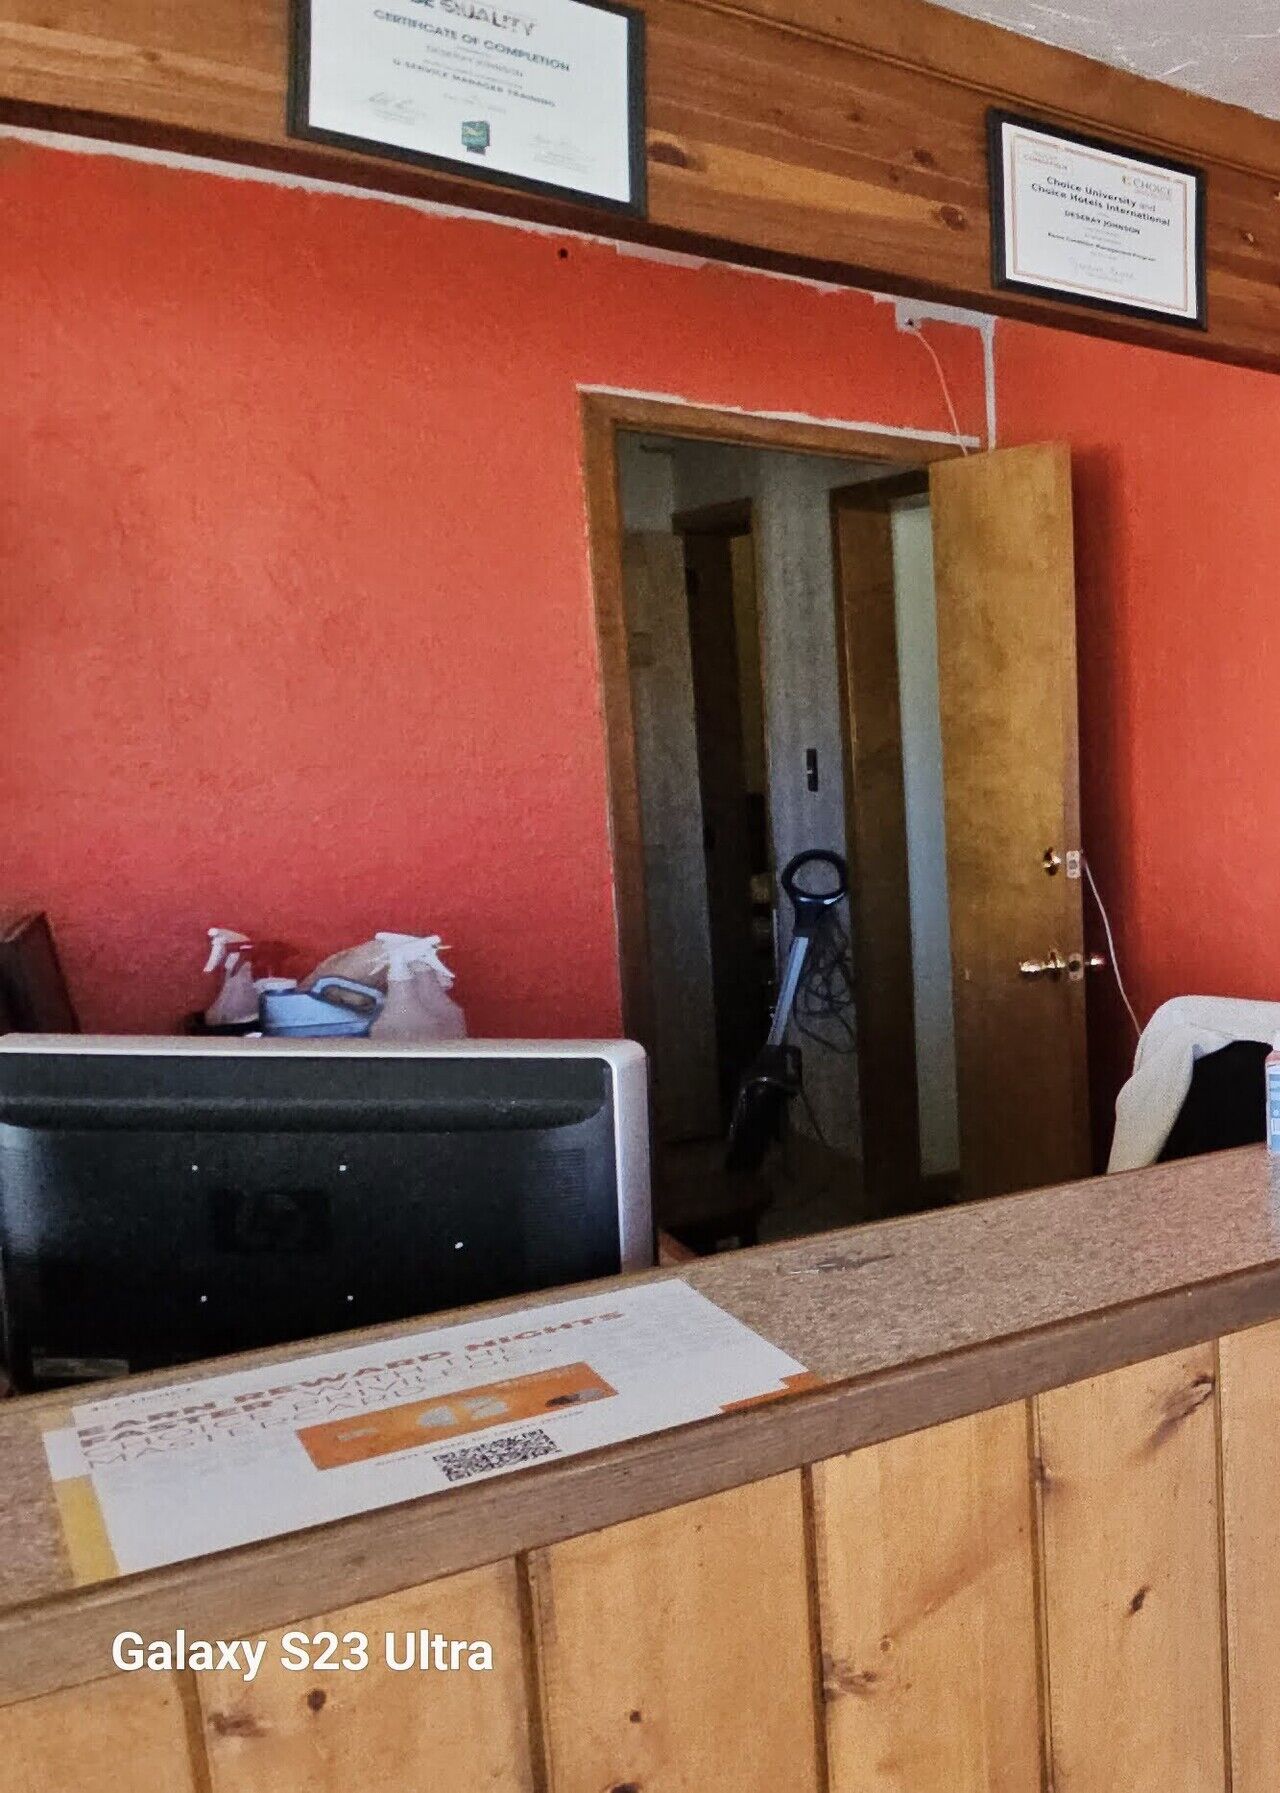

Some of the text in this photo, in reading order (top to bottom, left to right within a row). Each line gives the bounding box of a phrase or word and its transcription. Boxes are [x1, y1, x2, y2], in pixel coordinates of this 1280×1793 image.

[373, 9, 571, 72] CERTIFICATE OF COMPLETION
[1031, 182, 1170, 227] Choice Hotels International
[1046, 176, 1082, 193] Choice
[1085, 186, 1137, 208] University
[77, 1401, 217, 1438] EARN
[233, 1349, 452, 1404] REWARD
[464, 1310, 626, 1352] NIGHTS
